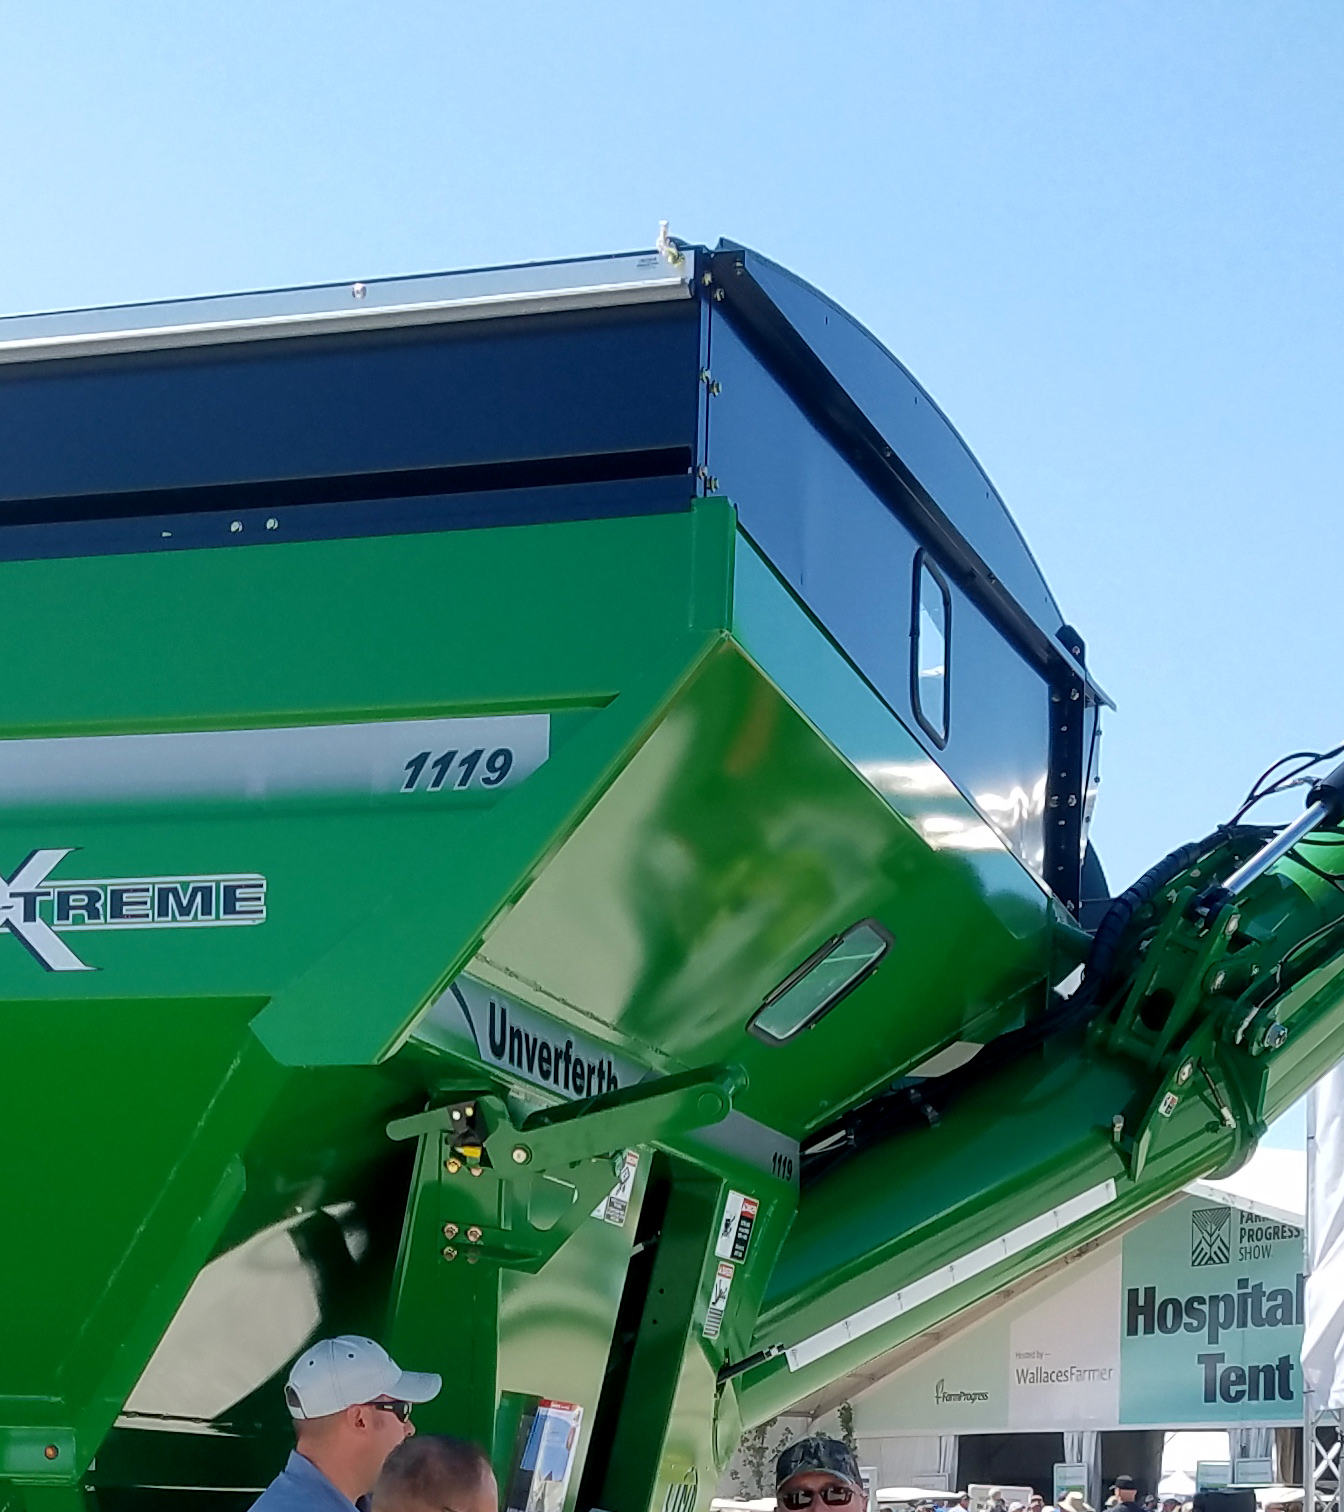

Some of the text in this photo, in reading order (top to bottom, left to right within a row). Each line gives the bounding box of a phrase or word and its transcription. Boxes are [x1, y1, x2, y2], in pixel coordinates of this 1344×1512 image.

[401, 748, 514, 792] 1119
[489, 1001, 620, 1099] Unverferth
[772, 1152, 794, 1182] 1119
[1240, 1225, 1301, 1244] PROGRESS
[1197, 1353, 1294, 1403] Tent
